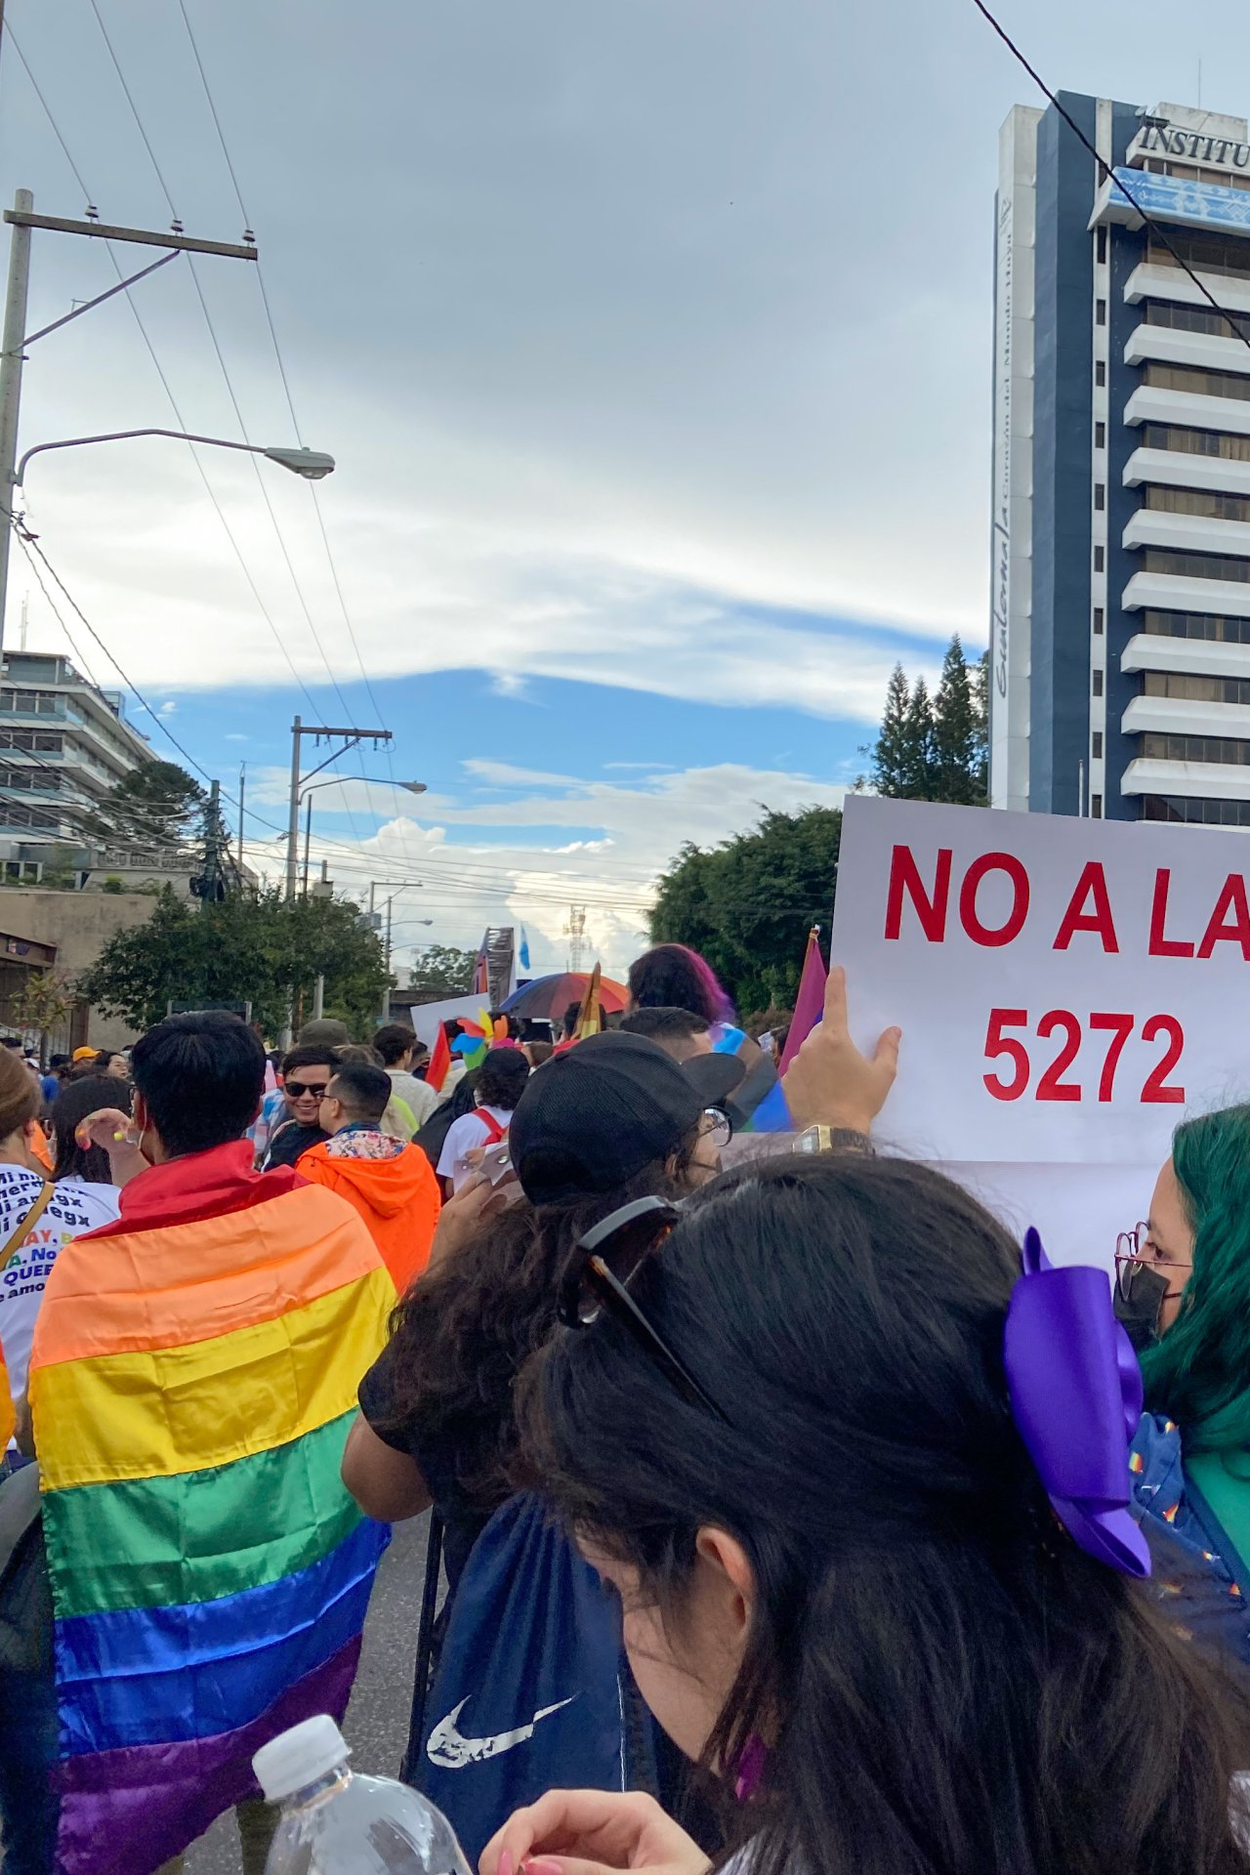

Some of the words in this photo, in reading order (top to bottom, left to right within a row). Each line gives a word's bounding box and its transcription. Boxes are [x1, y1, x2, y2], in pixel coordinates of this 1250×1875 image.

[993, 507, 1010, 699] Guatemala
[884, 844, 1030, 948] NO
[1052, 861, 1120, 954] A
[982, 1008, 1186, 1104] 5272
